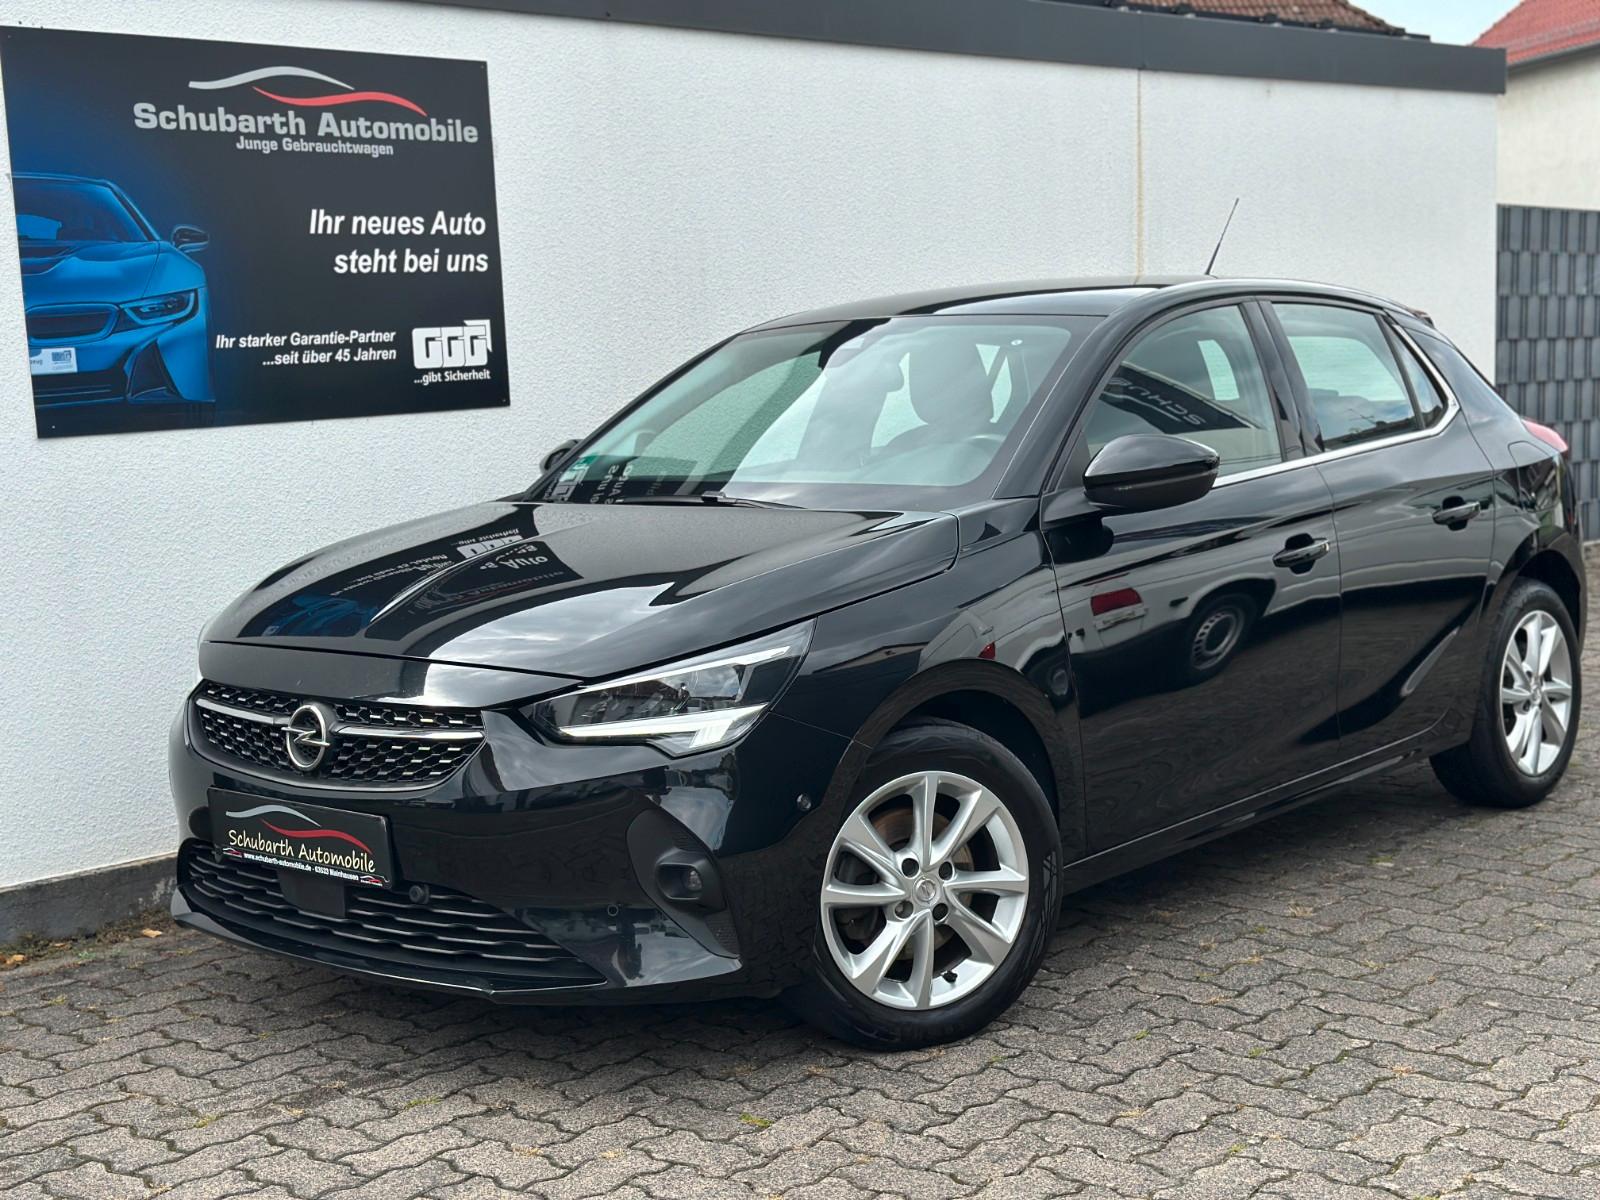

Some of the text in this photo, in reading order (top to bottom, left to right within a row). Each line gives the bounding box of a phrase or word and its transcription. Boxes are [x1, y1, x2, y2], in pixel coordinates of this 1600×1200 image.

[133, 101, 479, 145] Schubarth Automobile
[235, 136, 394, 157] Junge Gebrauchtwagen
[309, 208, 486, 236] Ihr neues Auto
[333, 247, 489, 274] steht bei uns
[215, 330, 397, 349] Ihr starker Garantie-Partner
[262, 347, 397, 366] ...seit über 45 Jahren
[414, 369, 491, 386] ...gibt Sicherheit
[228, 829, 376, 873] Schubarth Automobile
